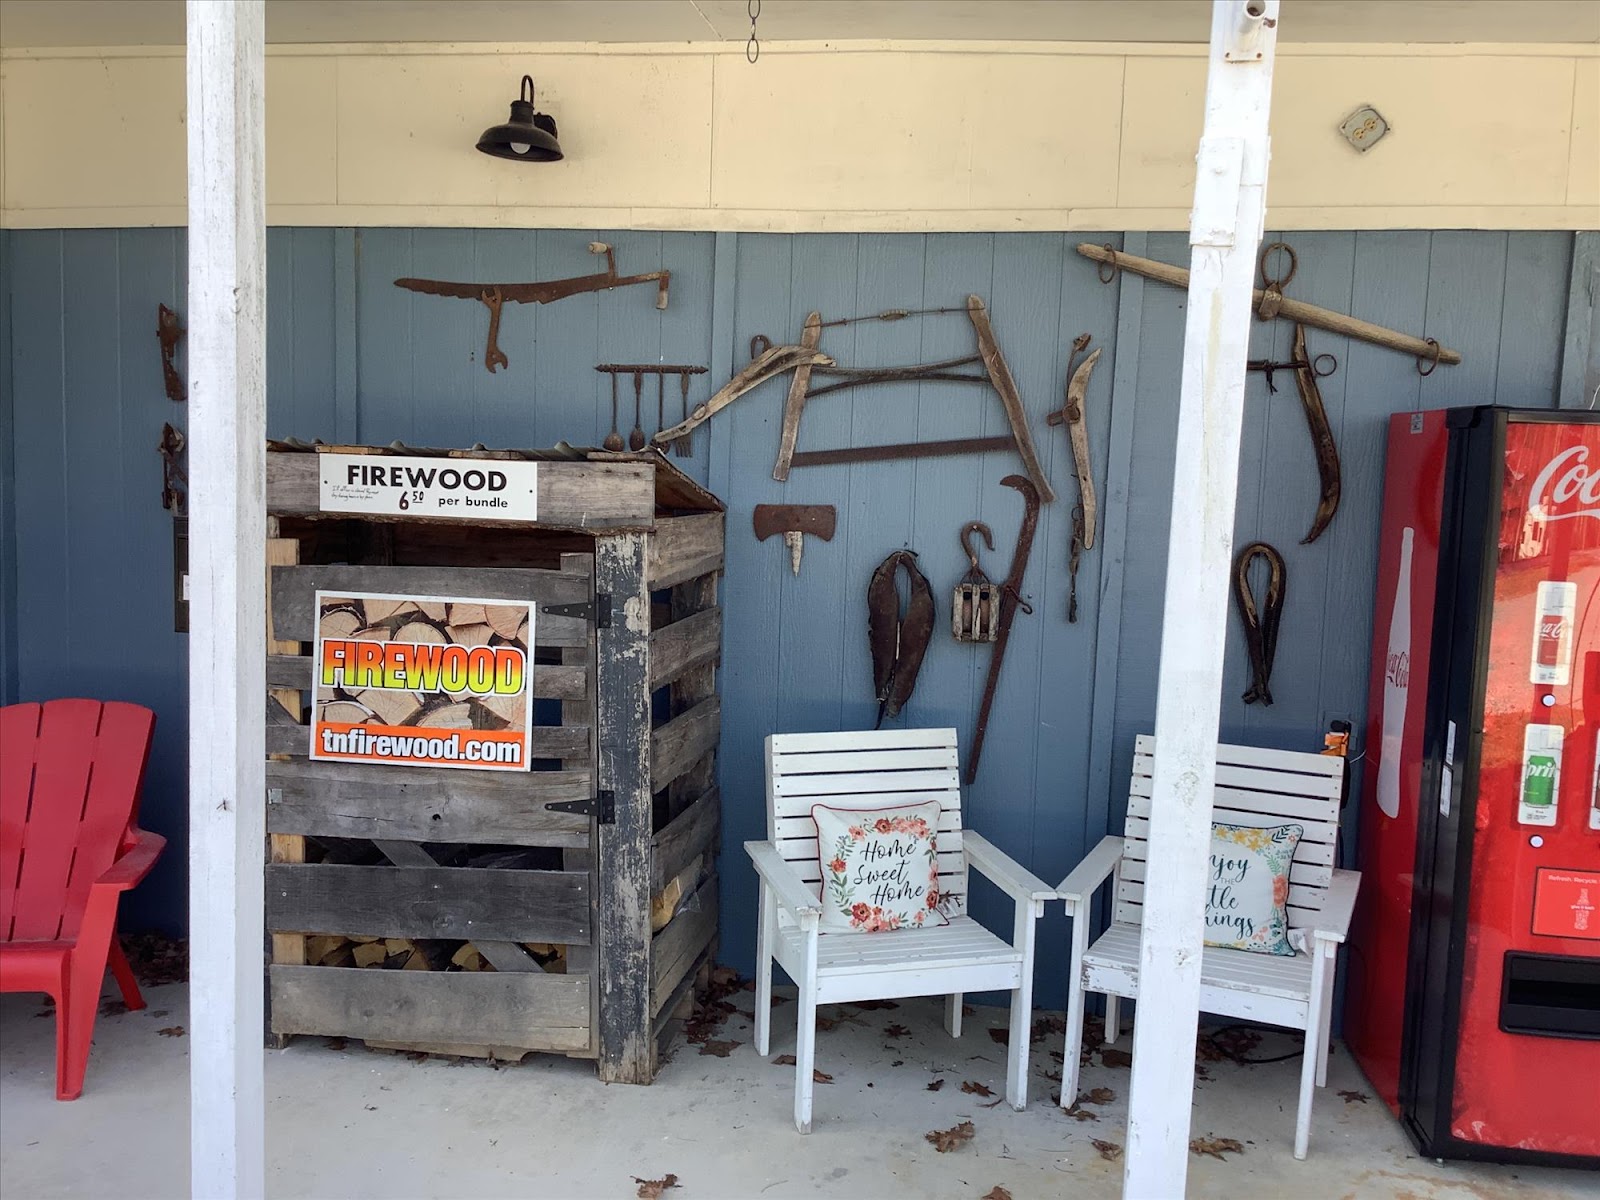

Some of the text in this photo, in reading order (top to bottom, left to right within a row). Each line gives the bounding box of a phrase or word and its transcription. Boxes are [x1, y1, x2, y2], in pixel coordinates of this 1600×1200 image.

[347, 465, 508, 491] FIREWOOD
[399, 490, 409, 510] 6
[438, 497, 459, 508] per
[466, 495, 508, 508] bundle
[321, 639, 525, 695] FIREWOOD
[321, 728, 521, 763] tnfirewood.com
[860, 839, 918, 863] Home
[853, 859, 910, 885] Sweet
[1209, 854, 1251, 882] njoy
[1220, 877, 1236, 885] THE
[869, 880, 925, 906] Home
[1207, 885, 1239, 909] tle
[1205, 909, 1256, 940] ings
